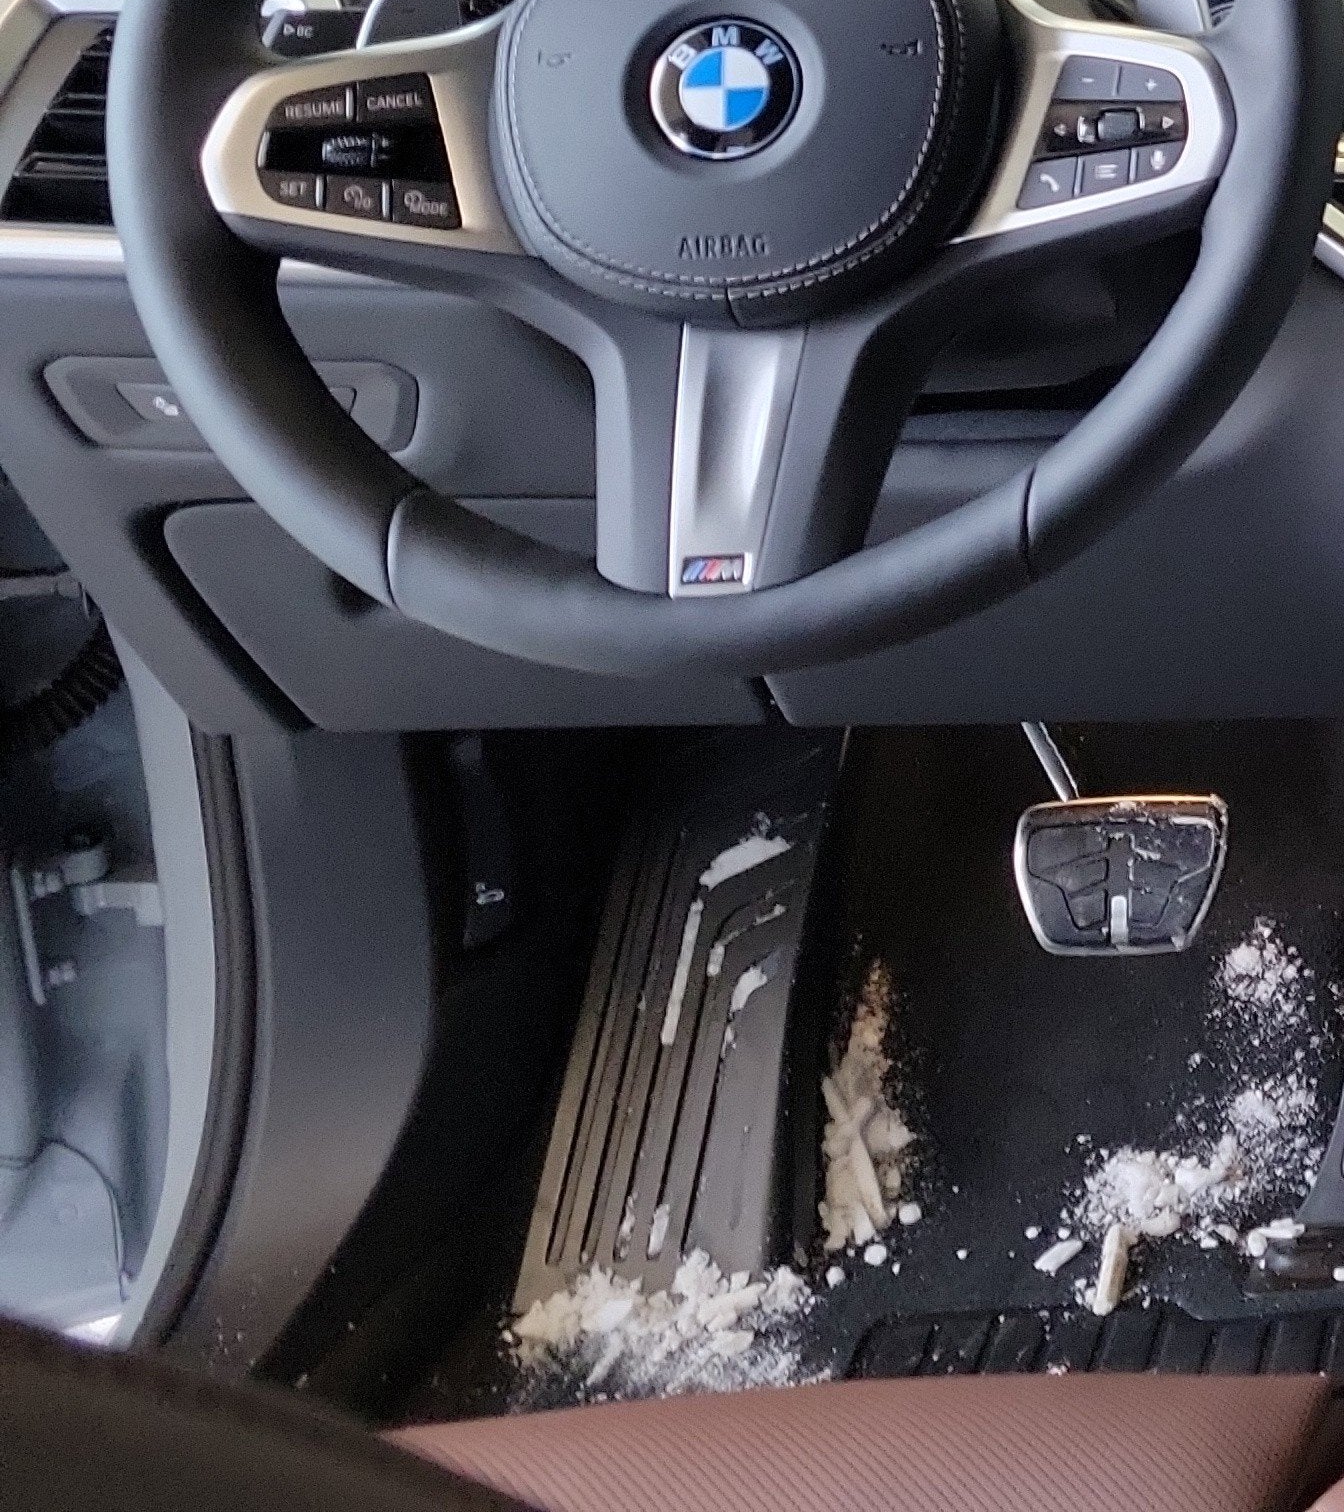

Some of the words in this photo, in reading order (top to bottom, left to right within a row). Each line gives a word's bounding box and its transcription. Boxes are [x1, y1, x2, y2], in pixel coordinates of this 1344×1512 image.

[667, 24, 785, 69] BMW
[285, 99, 345, 120] RESUME
[366, 92, 423, 111] CANCEL
[679, 233, 770, 260] AIRBAG
